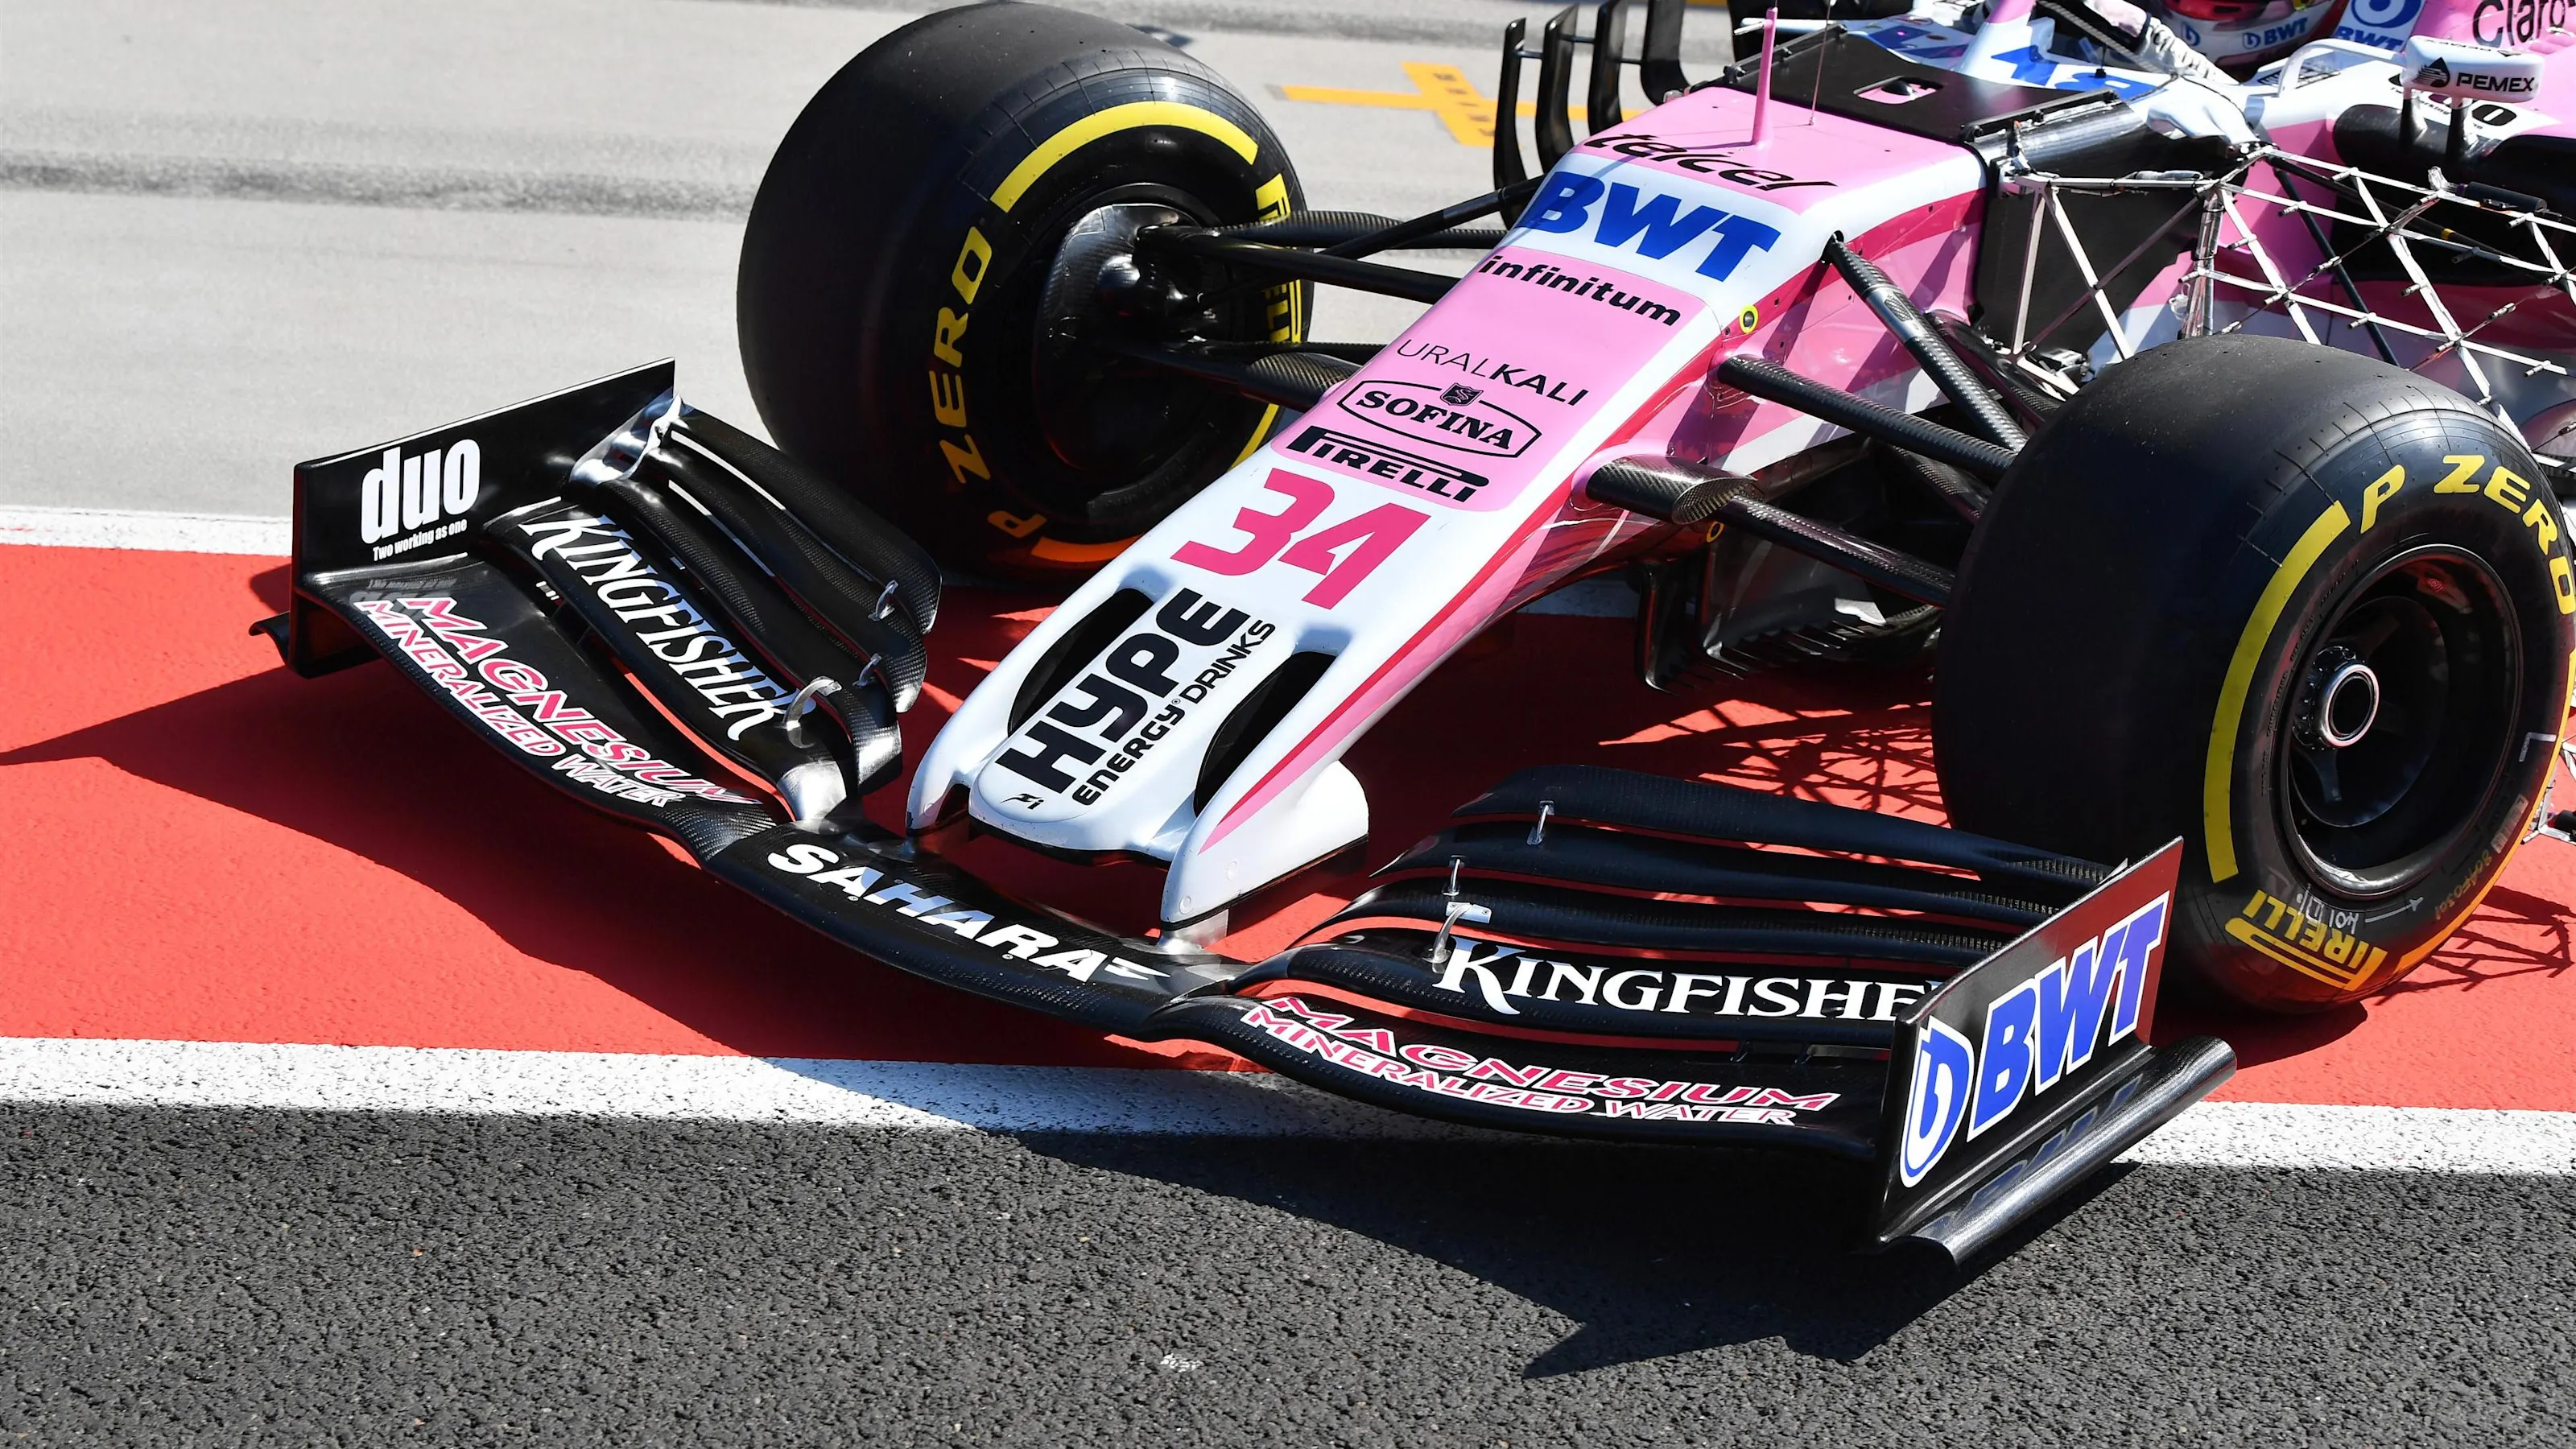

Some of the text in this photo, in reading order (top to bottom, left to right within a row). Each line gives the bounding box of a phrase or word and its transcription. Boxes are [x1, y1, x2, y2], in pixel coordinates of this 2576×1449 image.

[2264, 17, 2308, 46] BWT
[2457, 72, 2535, 93] PEMEX
[1583, 134, 1839, 191] telcel
[1518, 171, 1781, 283] BWT
[1479, 255, 1682, 327] infinitum
[929, 226, 993, 484] ZERO
[1397, 338, 1590, 407] URALKALI
[1286, 425, 1490, 503] PIRELLI
[1355, 390, 1513, 451] SOFINA
[361, 439, 481, 544] duo
[373, 518, 468, 562] Two working as one
[1170, 468, 1431, 610] 34
[2360, 464, 2406, 535] P
[2433, 454, 2576, 616] ZERO
[518, 514, 817, 741] KINGFISHER
[1186, 619, 1277, 704] DRINKS
[353, 600, 683, 807] MINERALIZED WATER
[394, 597, 763, 805] MAGNESIUM
[995, 588, 1251, 795] HYPE
[768, 843, 1108, 984] SAHARA
[2225, 890, 2388, 992] PIRELLI
[1433, 935, 1943, 1021] KINGFISHE
[1967, 890, 2170, 1143] BWT
[1240, 1005, 1797, 1127] MINERALIZED WATER
[1269, 997, 1841, 1112] MAGNESIUM
